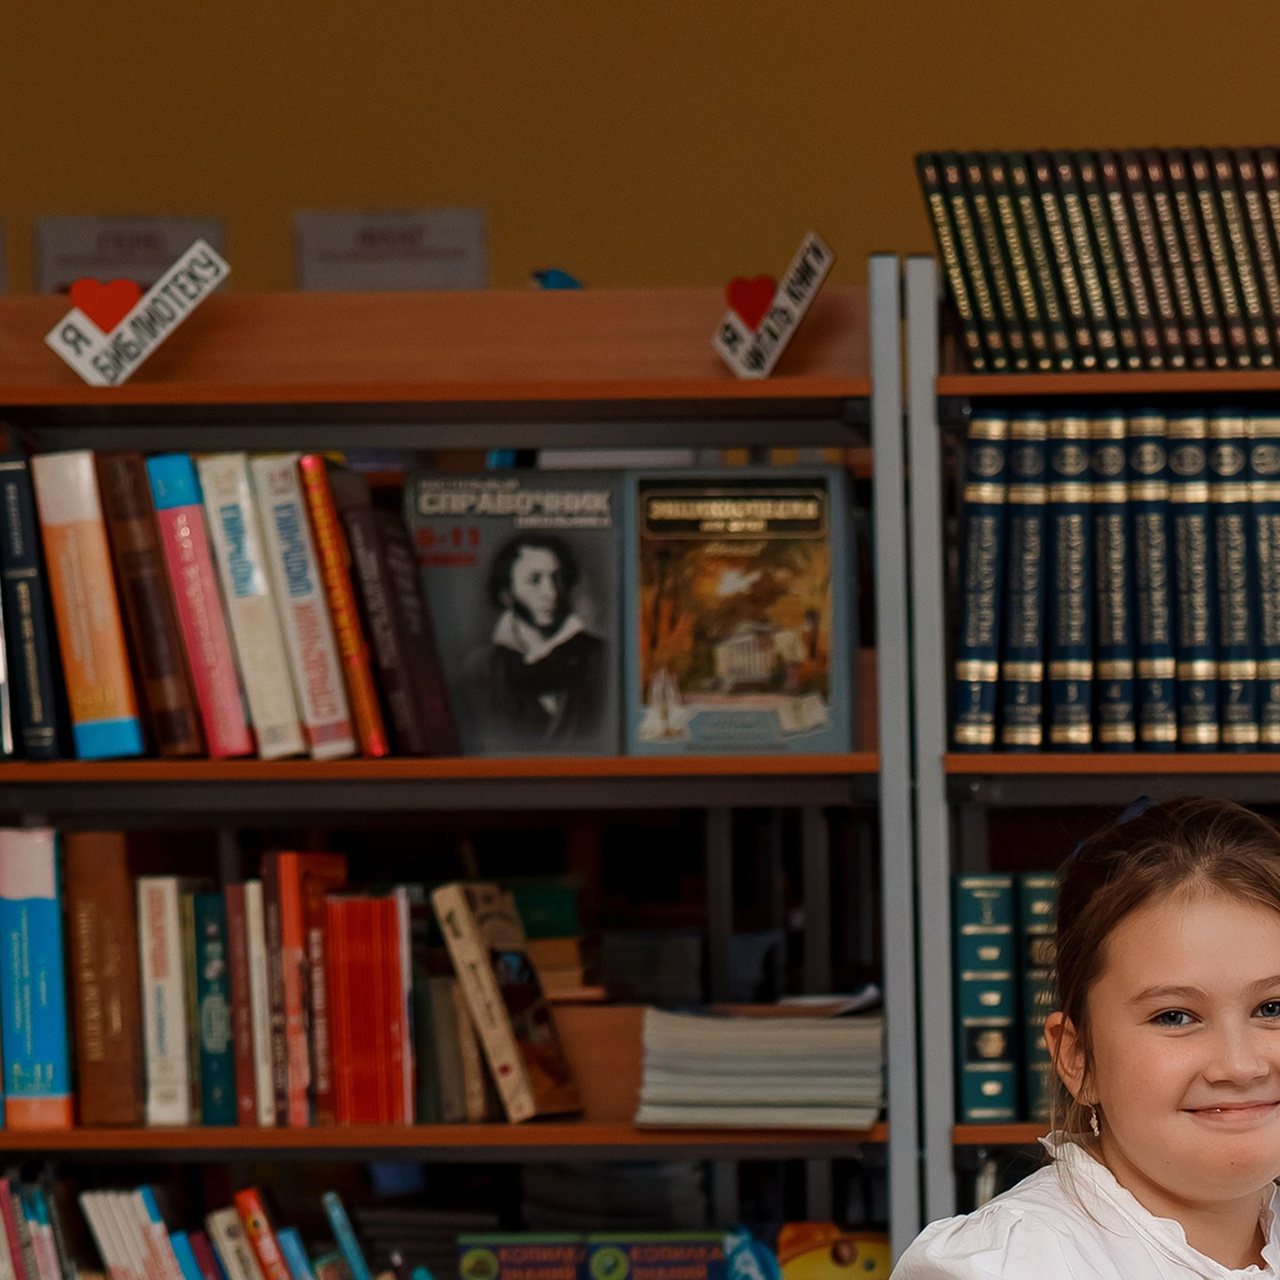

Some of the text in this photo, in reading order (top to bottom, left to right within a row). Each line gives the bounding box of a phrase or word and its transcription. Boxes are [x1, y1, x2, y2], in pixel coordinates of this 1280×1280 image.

[91, 248, 222, 383] БИБЛИОТЕКУ
[60, 322, 92, 357] Я
[418, 492, 611, 516] СПРАВОЧНИК
